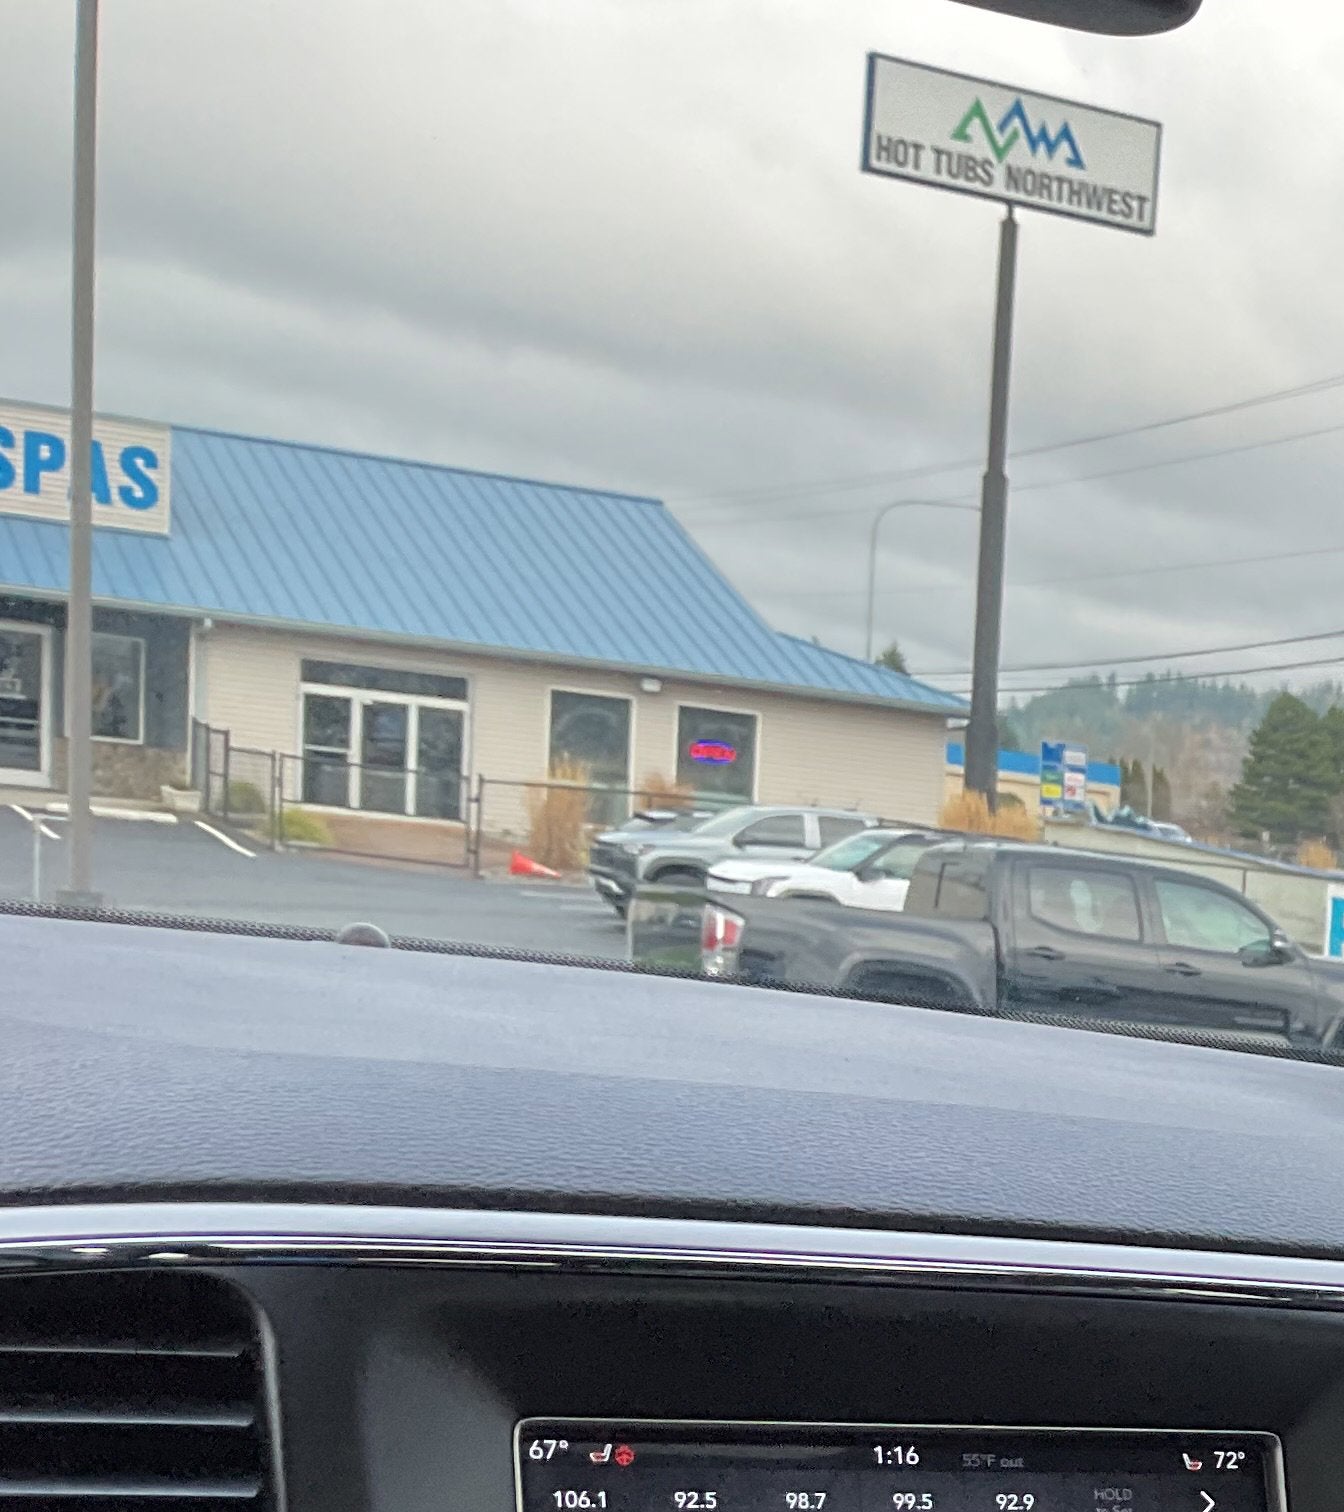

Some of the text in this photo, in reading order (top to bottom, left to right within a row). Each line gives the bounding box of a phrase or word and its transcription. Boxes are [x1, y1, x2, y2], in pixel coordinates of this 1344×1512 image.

[875, 134, 1151, 222] HOT TUBS NORTHWEST
[873, 1445, 920, 1466] 1:16
[552, 1490, 607, 1509] 106.1
[674, 1491, 717, 1509] 92.5
[785, 1492, 827, 1510] 98.7
[892, 1493, 933, 1511] 99.5
[995, 1494, 1035, 1511] 92.9
[1093, 1487, 1133, 1501] HOLD
